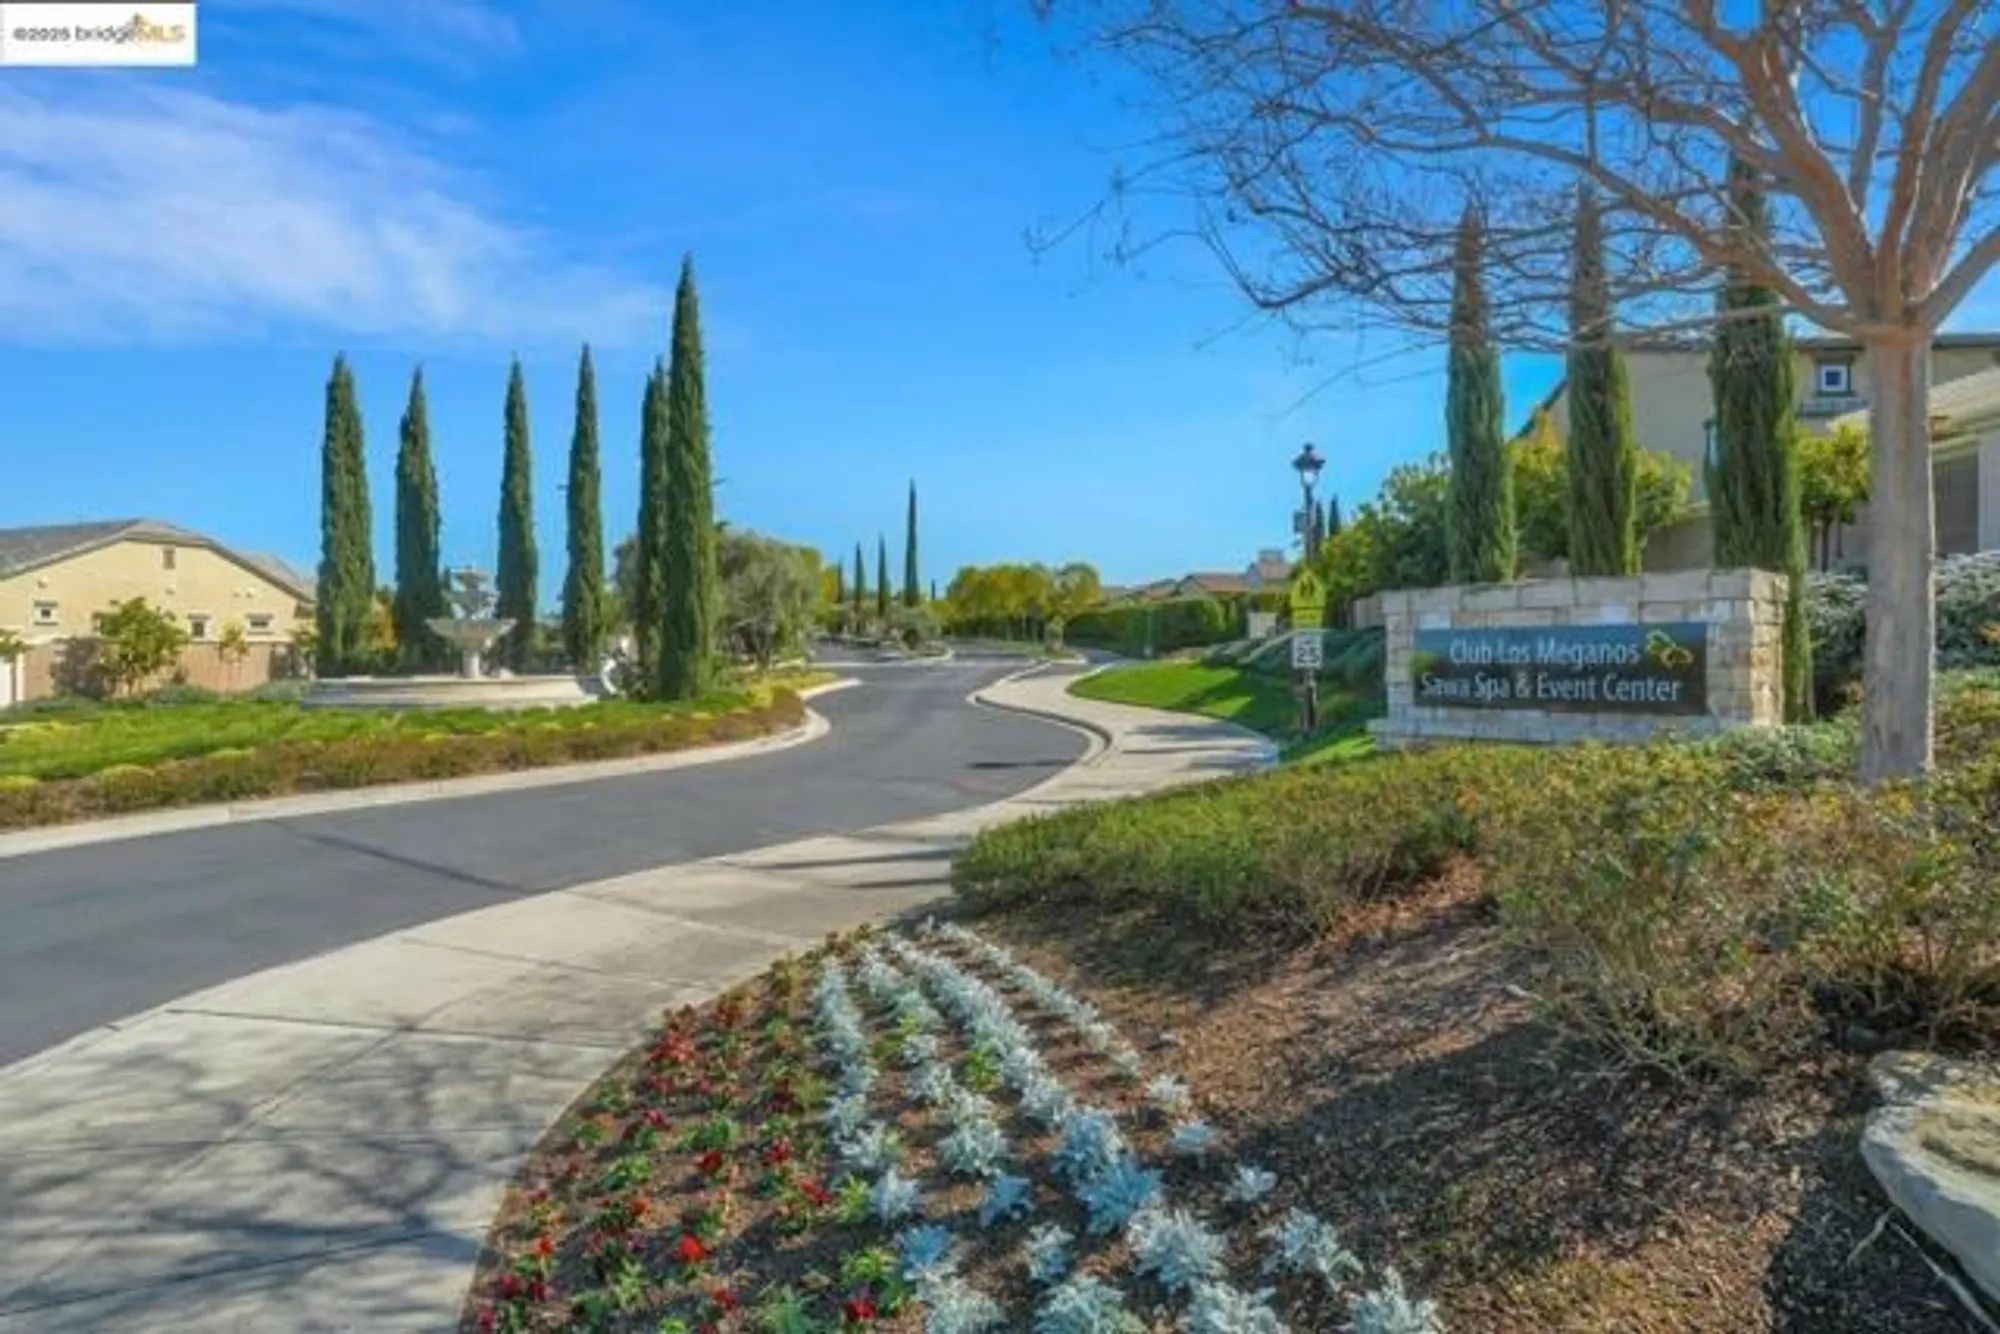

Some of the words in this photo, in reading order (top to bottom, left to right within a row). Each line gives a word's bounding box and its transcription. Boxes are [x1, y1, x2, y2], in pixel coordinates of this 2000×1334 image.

[1296, 646, 1320, 664] 25
[1449, 637, 1492, 664] Club
[1496, 638, 1530, 663] Los
[1536, 635, 1641, 673] Meganos
[1474, 671, 1511, 702] Spa
[1515, 671, 1532, 698] &
[1536, 671, 1597, 700] Event
[1602, 672, 1682, 702] Center
